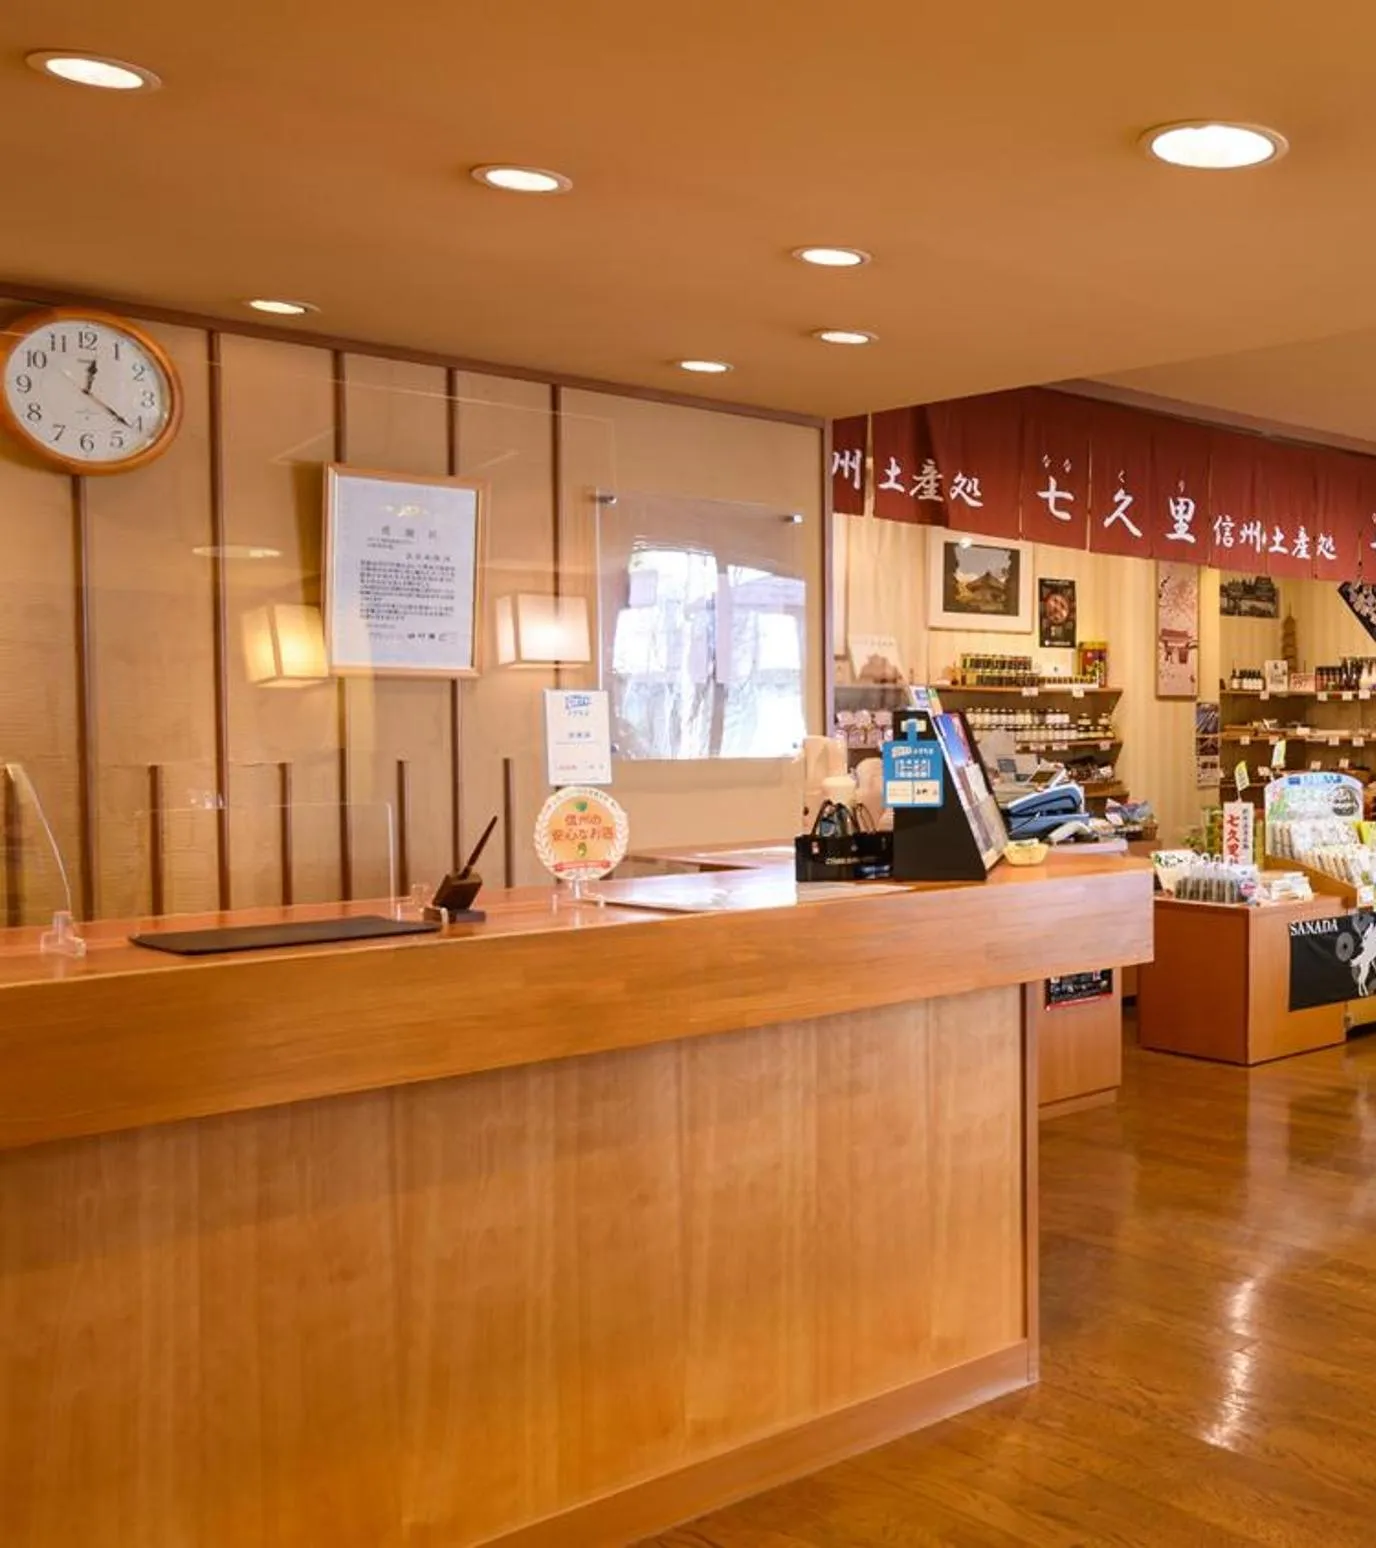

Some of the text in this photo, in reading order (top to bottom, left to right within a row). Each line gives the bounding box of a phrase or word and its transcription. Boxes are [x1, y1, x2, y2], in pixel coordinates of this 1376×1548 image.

[50, 333, 66, 352] 11
[78, 331, 98, 350] 12
[27, 351, 47, 369] 10
[113, 343, 120, 361] 1
[132, 363, 145, 381] 2
[15, 375, 32, 394] 9
[141, 391, 155, 408] 3
[27, 402, 42, 421] 8
[52, 424, 66, 441] 7
[110, 430, 124, 448] 5
[79, 433, 94, 451] 6
[1289, 918, 1339, 936] SANADA
